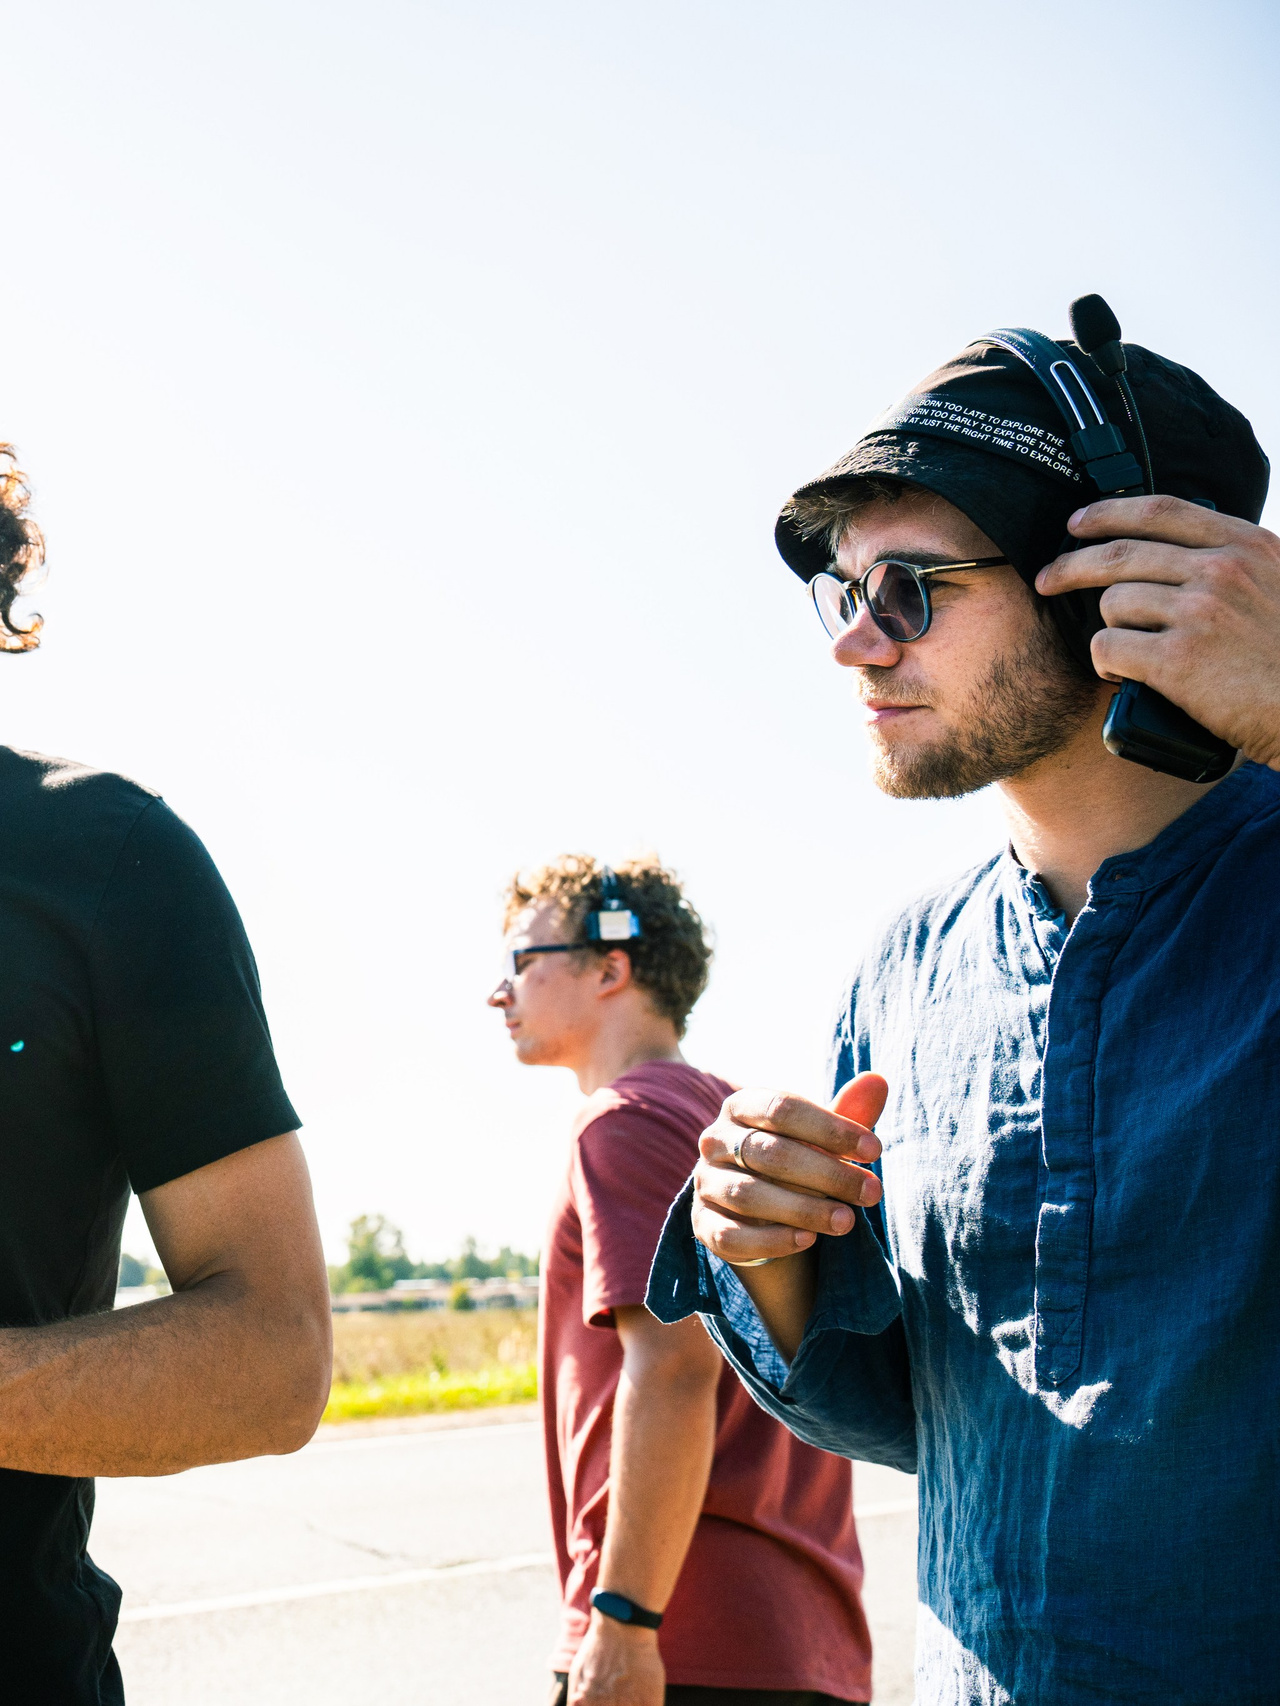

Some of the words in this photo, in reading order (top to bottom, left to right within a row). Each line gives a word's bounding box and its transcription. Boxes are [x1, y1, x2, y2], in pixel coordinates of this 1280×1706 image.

[907, 407, 930, 416] BORN
[930, 409, 949, 419] TOO
[949, 413, 979, 427] EARLY
[980, 423, 993, 432] TO
[993, 427, 1037, 446] EXPLORE
[1038, 441, 1058, 456] THE
[1057, 452, 1073, 465] GA
[919, 418, 942, 428] JUST
[942, 422, 962, 433] THE
[961, 427, 991, 441] RIGHT
[991, 436, 1015, 450] TIME
[1015, 443, 1029, 454] TO
[1029, 450, 1074, 477] EXPLORE
[920, 399, 942, 408] BORN
[943, 401, 962, 412] TOO
[963, 407, 987, 421] LATE
[988, 415, 1001, 425] TO
[1001, 419, 1045, 438] EXPLORE
[1045, 432, 1065, 447] THE
